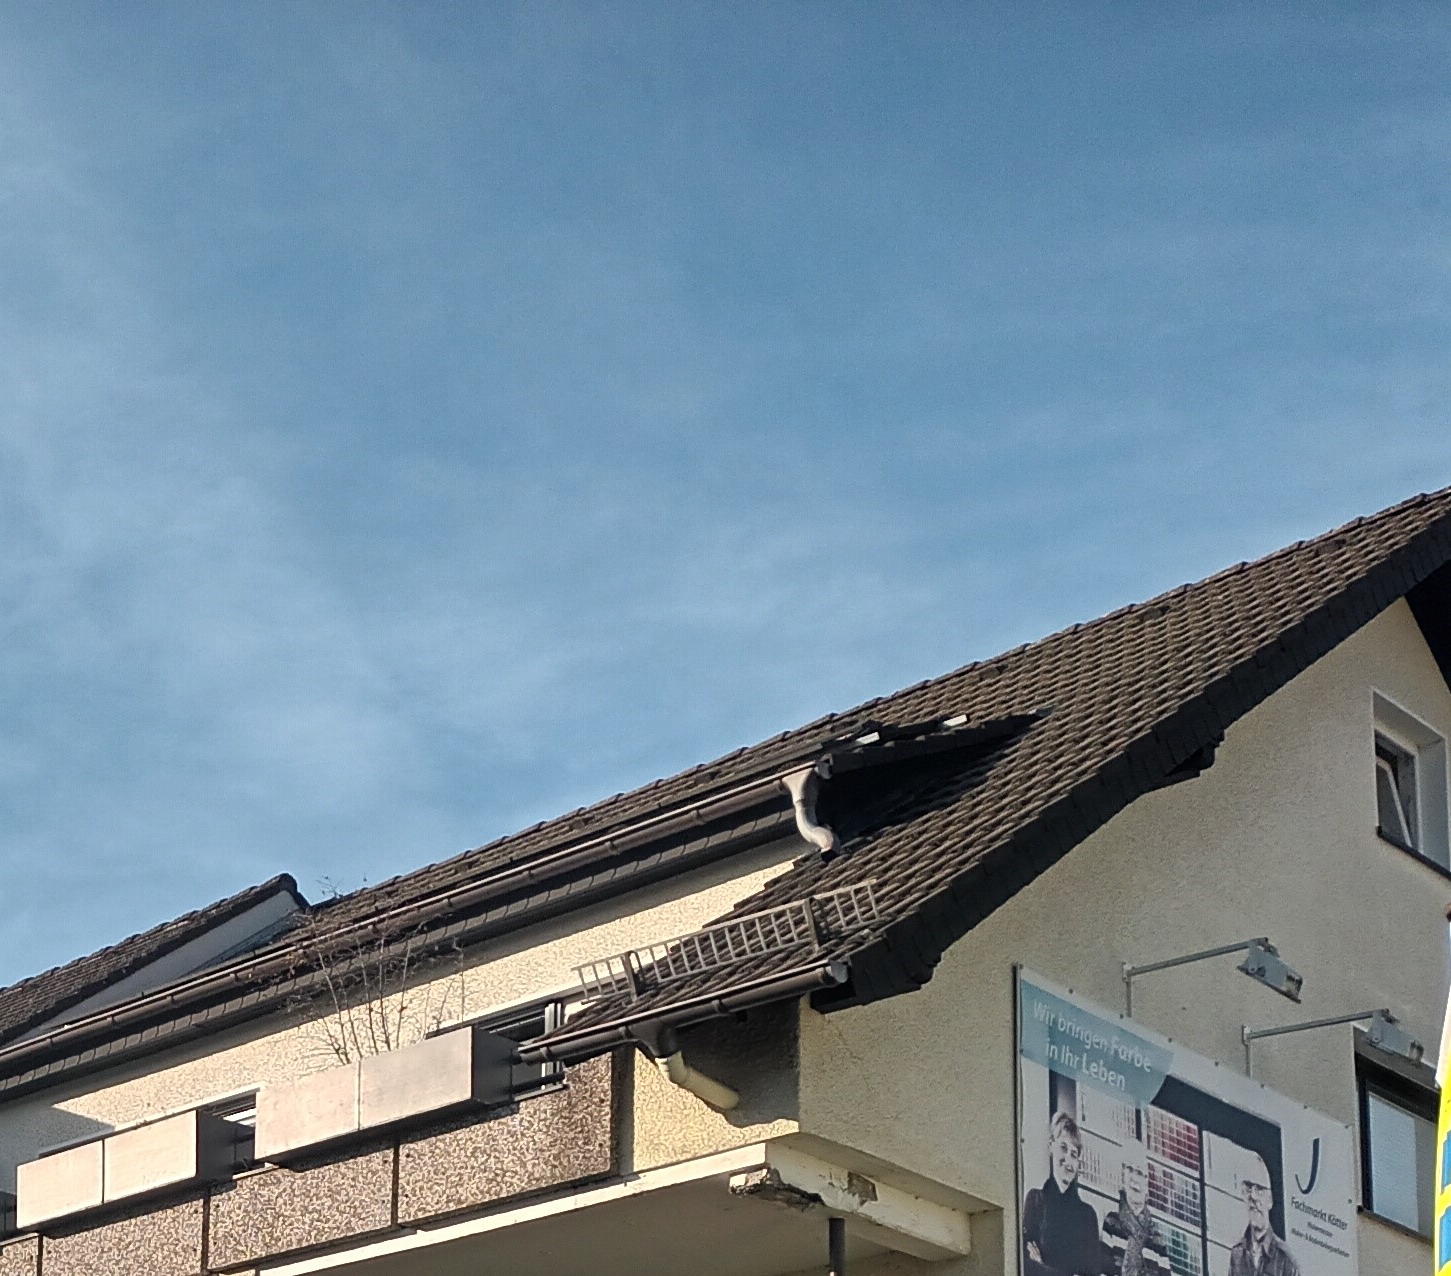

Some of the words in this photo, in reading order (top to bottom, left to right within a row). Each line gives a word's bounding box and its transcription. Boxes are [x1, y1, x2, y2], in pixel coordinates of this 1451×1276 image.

[1033, 1000, 1055, 1026] Wir
[1058, 1012, 1107, 1051] bringen
[1110, 1036, 1152, 1072] Farbe
[1046, 1037, 1058, 1060] in
[1061, 1044, 1080, 1069] Ihr
[1082, 1052, 1125, 1091] Leben
